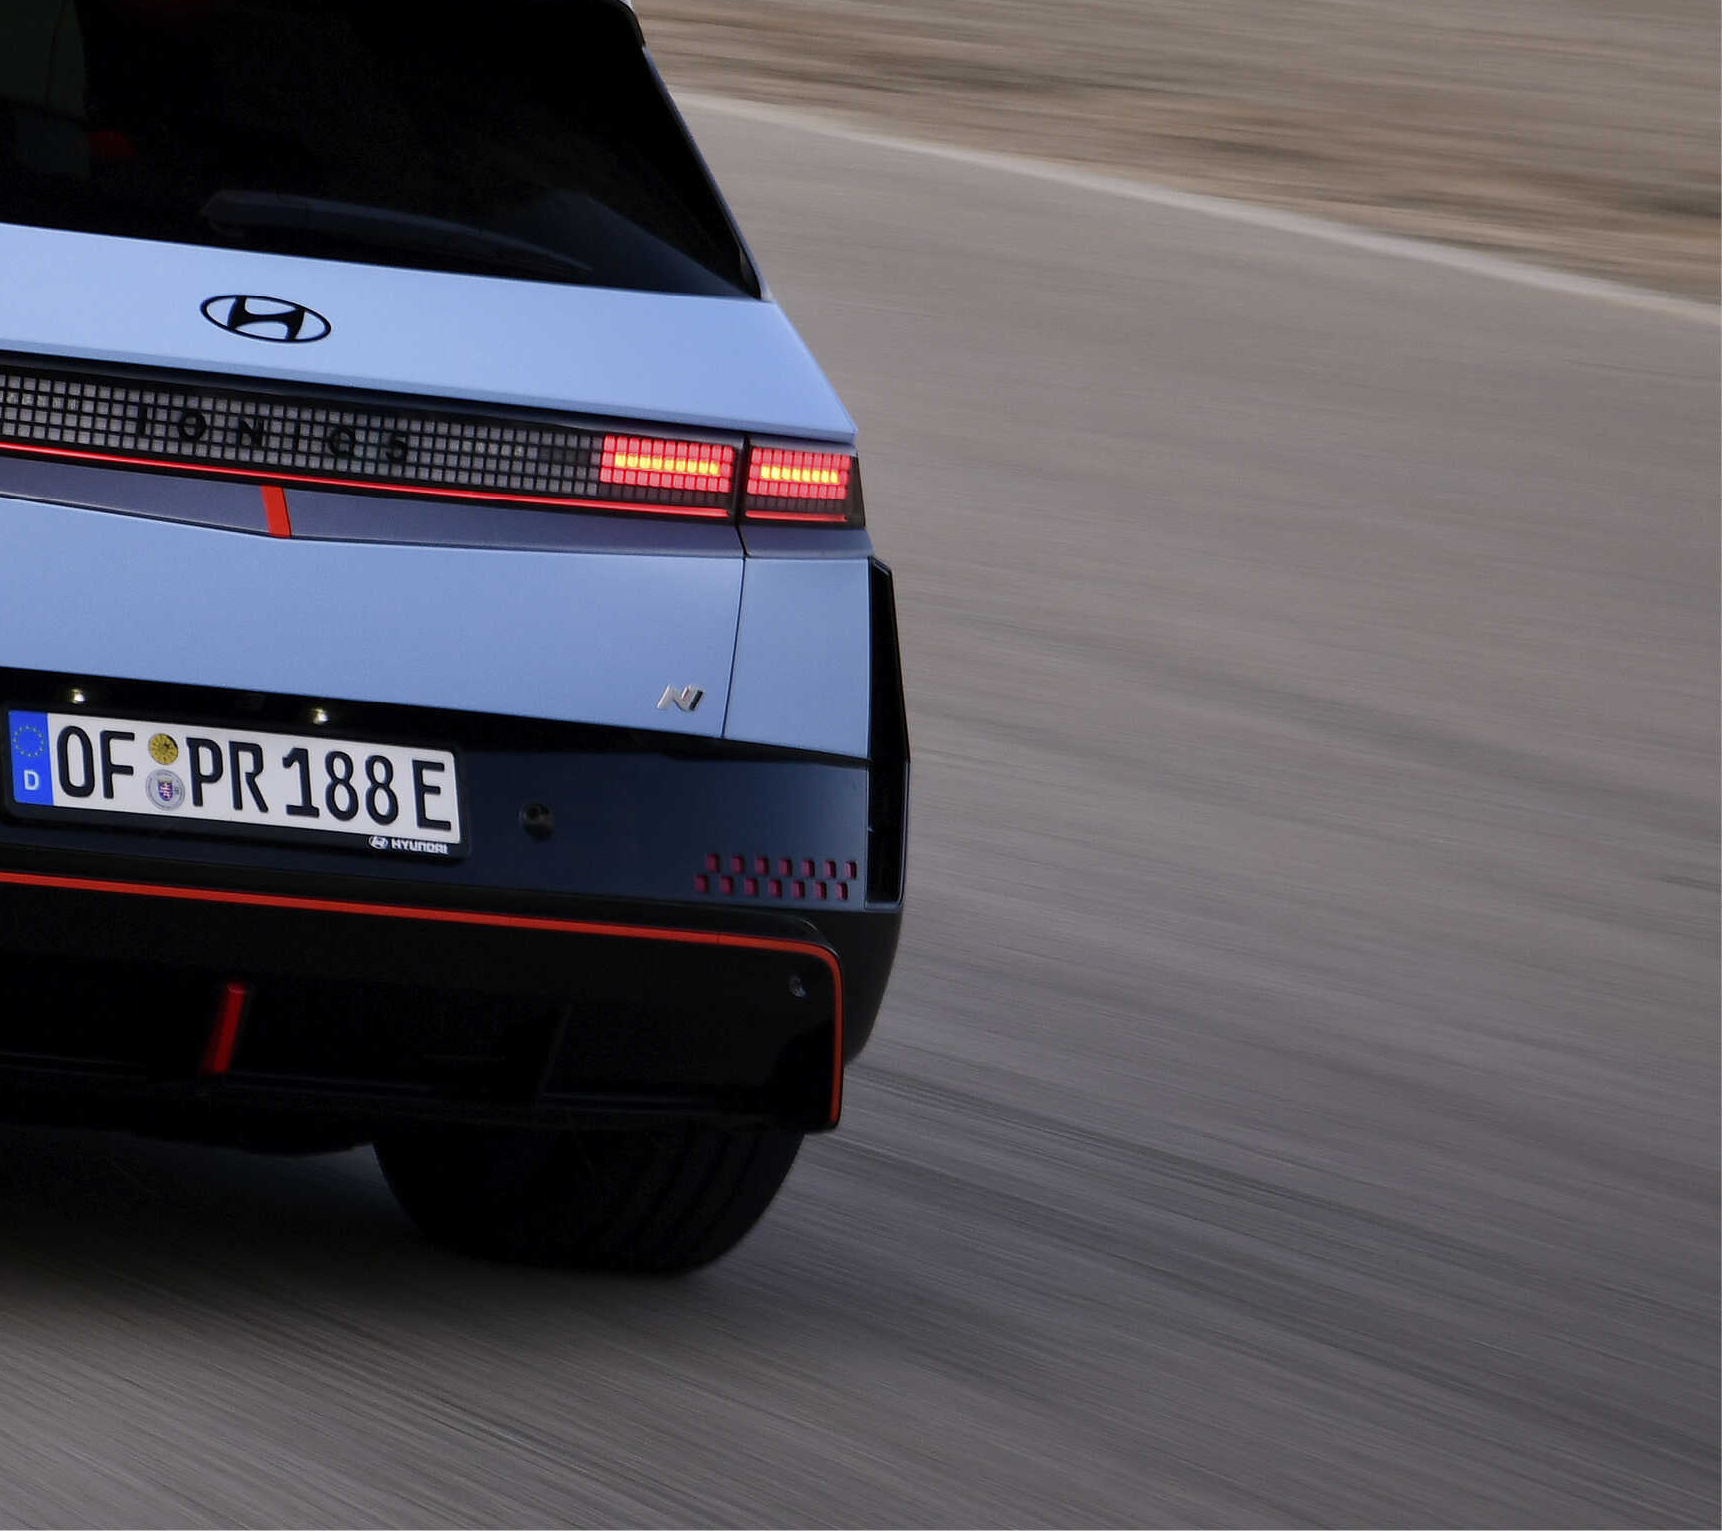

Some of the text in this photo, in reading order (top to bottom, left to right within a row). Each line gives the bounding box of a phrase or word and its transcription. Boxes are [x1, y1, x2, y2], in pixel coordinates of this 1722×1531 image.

[57, 725, 135, 799] OF
[23, 769, 40, 791] D
[391, 838, 448, 854] HYUNDAI
